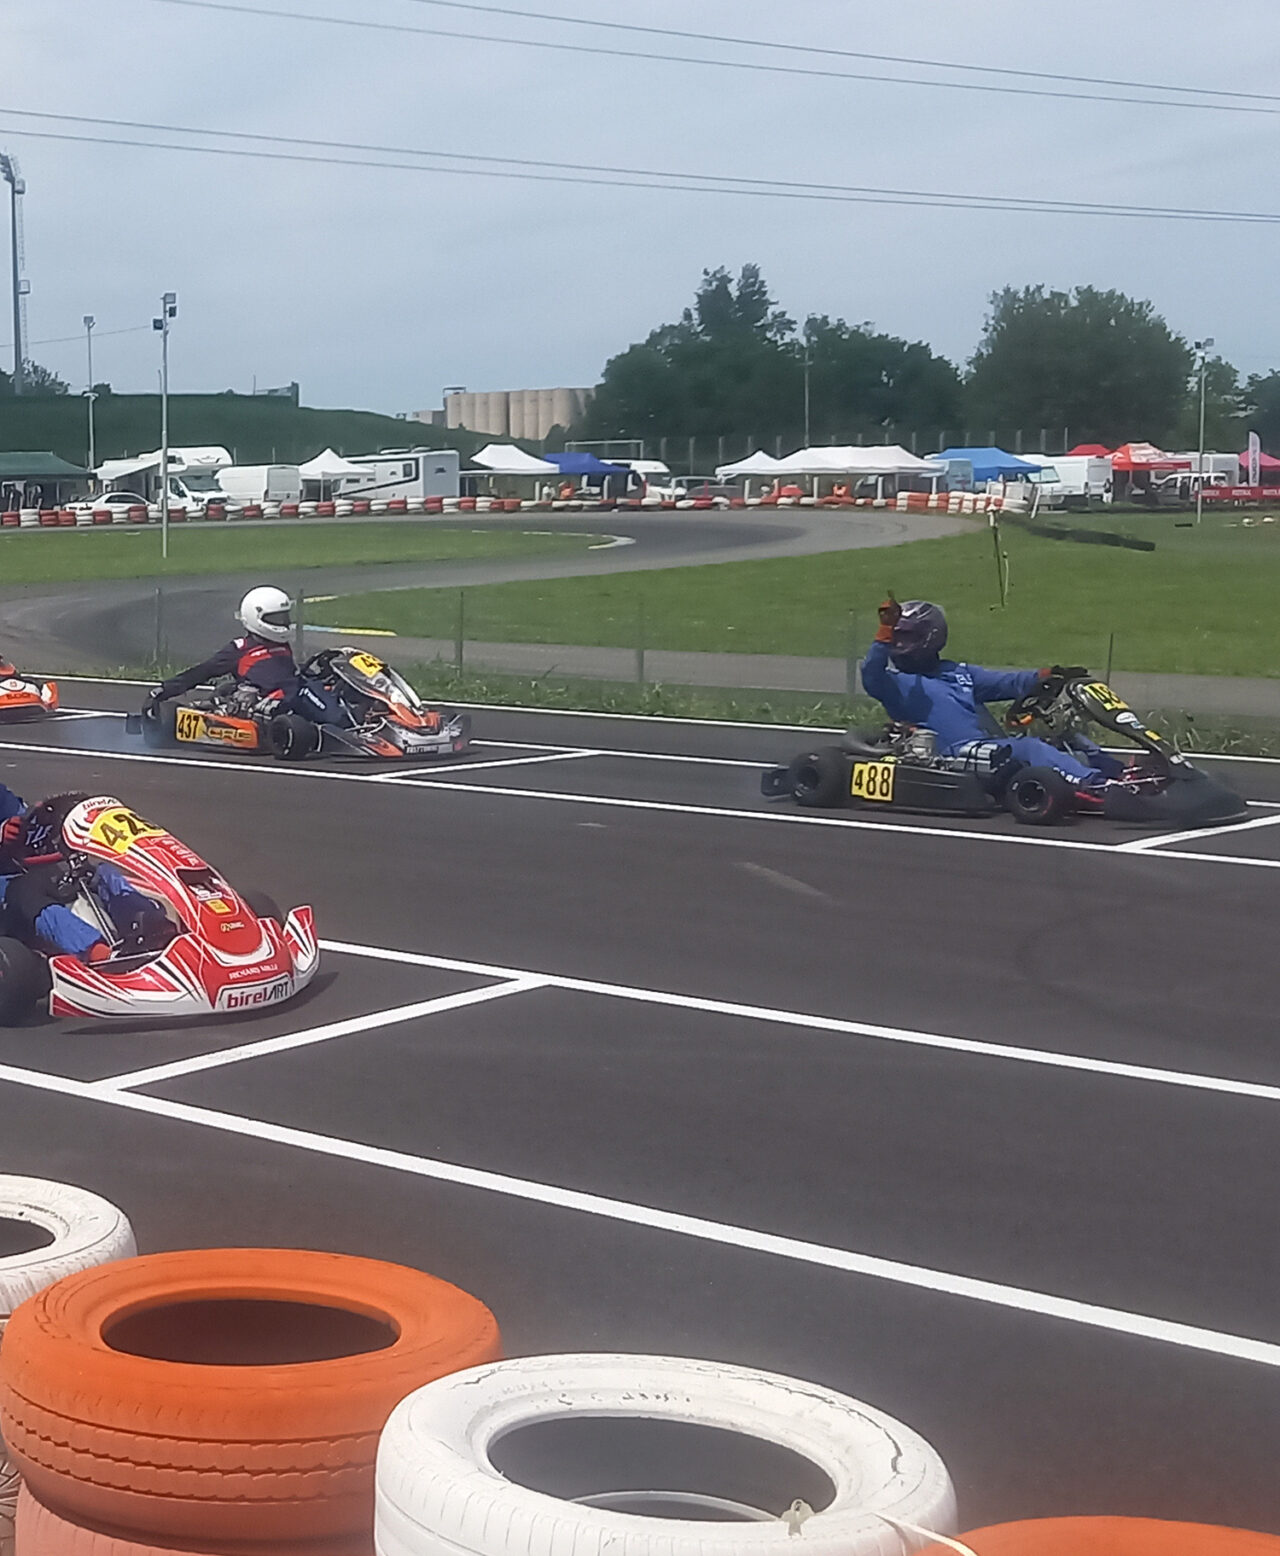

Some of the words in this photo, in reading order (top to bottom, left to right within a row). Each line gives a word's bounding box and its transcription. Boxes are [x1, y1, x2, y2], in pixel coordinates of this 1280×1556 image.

[177, 713, 200, 739] 437
[854, 765, 891, 797] 488
[227, 981, 289, 1010] birelART
